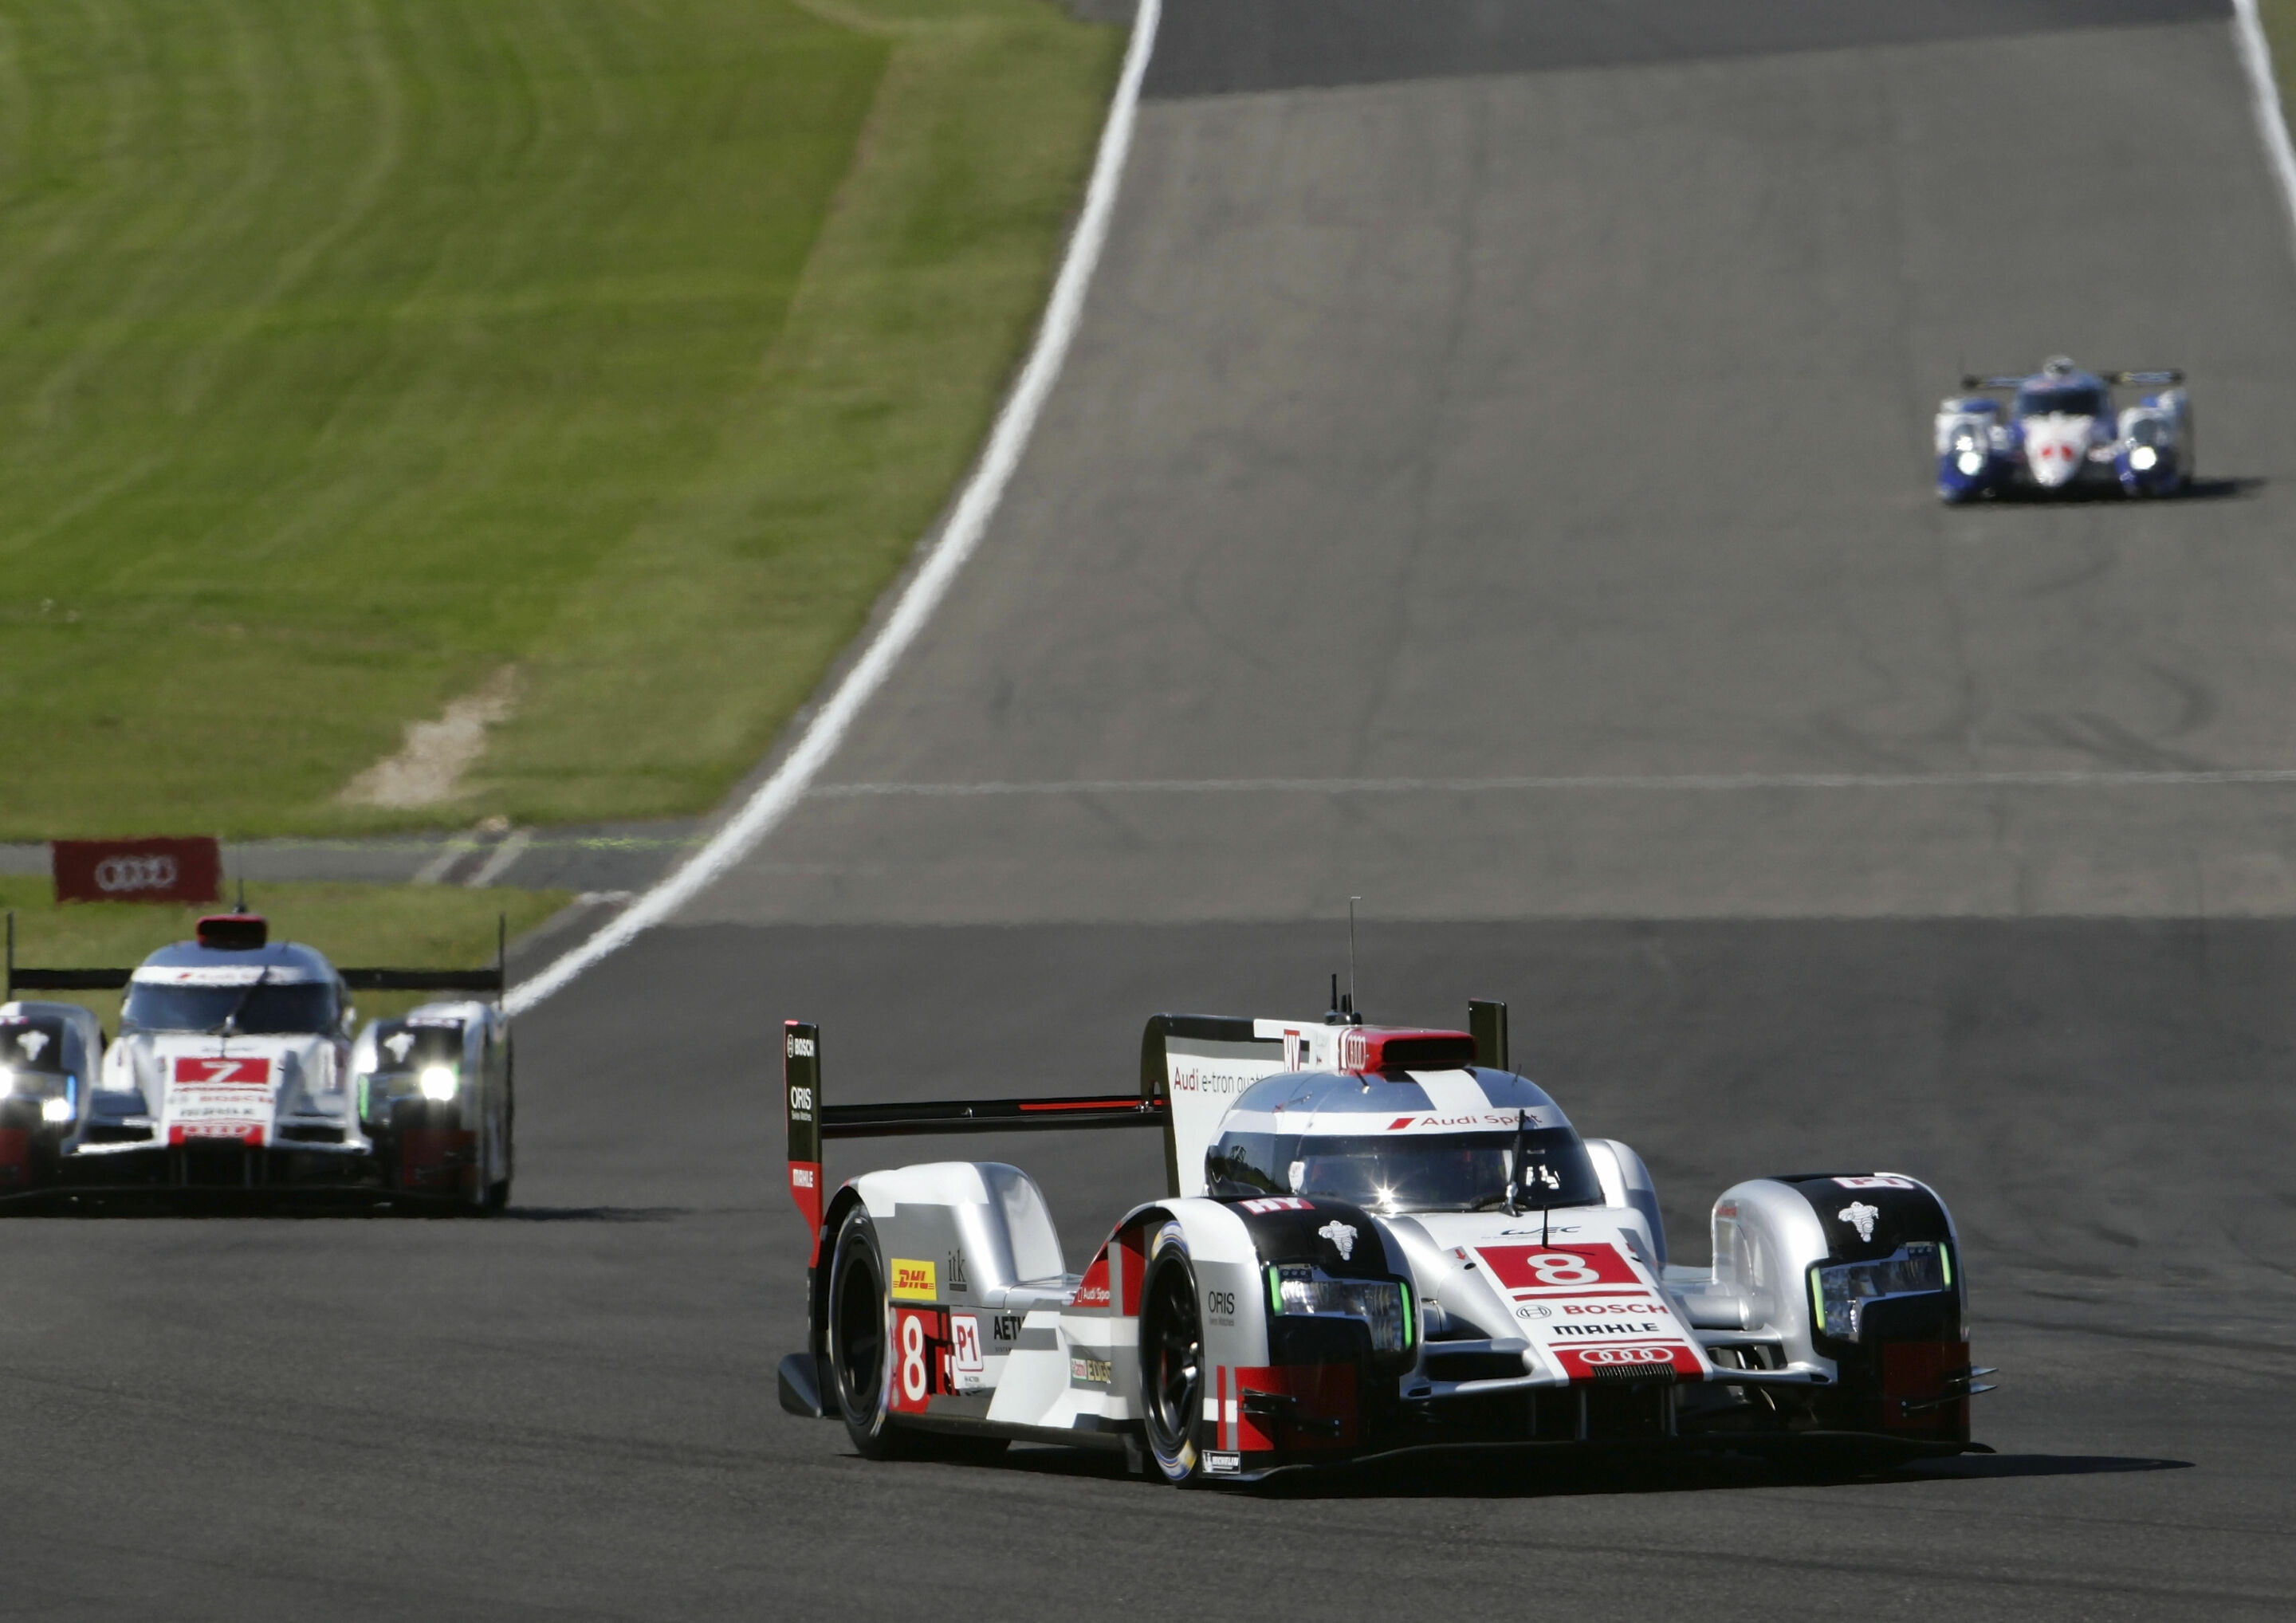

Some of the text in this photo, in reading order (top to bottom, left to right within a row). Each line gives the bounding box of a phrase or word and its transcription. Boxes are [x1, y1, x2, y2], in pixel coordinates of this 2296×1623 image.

[795, 1038, 814, 1057] BOSCH
[201, 1061, 244, 1083] 7
[1174, 1067, 1199, 1091] Audi
[1202, 1072, 1234, 1093] e-tron
[791, 1086, 812, 1110] ORIS
[1421, 1115, 1477, 1127] Audi
[1242, 1197, 1303, 1212] HY
[948, 1251, 965, 1283] itk
[1527, 1253, 1600, 1286] 8
[899, 1269, 929, 1289] DHL
[1209, 1291, 1235, 1315] ORIS
[1563, 1303, 1670, 1315] BOSCH
[1552, 1322, 1661, 1335] MAHLE
[957, 1325, 977, 1362] P1
[902, 1315, 927, 1401] 8
